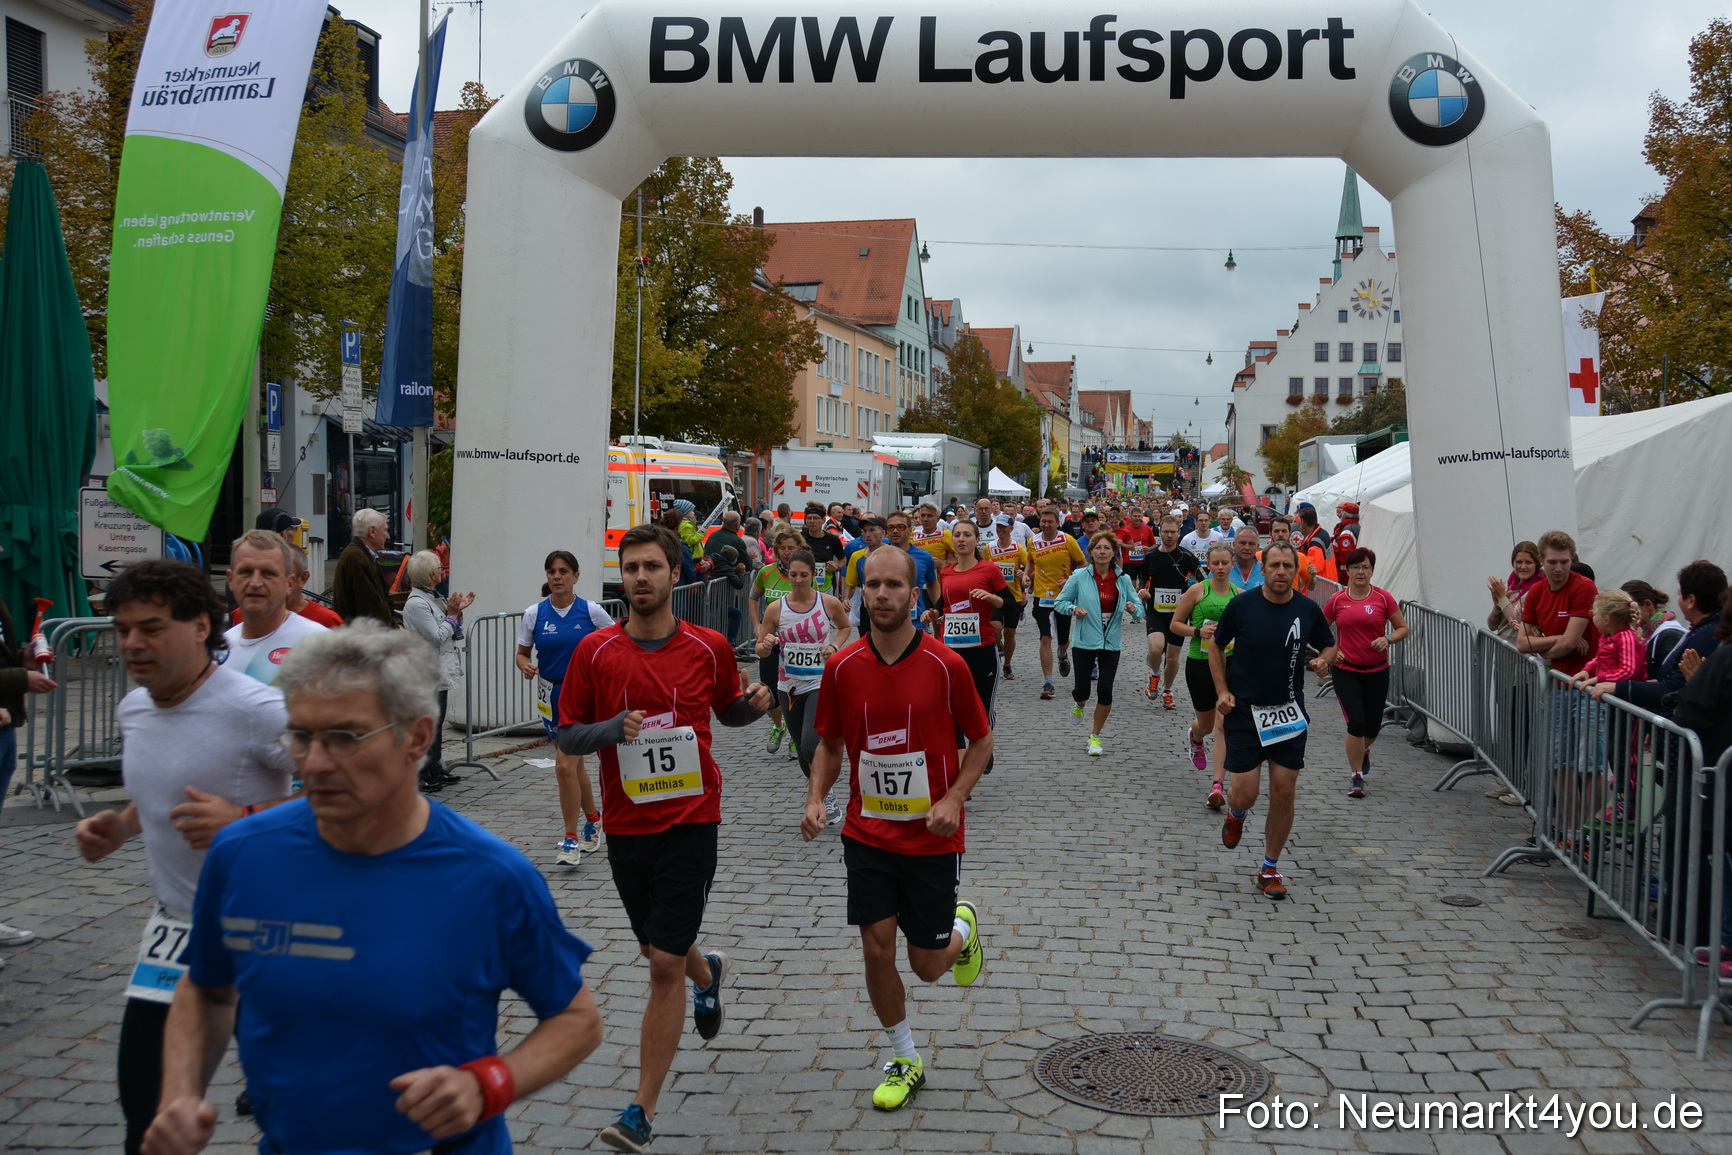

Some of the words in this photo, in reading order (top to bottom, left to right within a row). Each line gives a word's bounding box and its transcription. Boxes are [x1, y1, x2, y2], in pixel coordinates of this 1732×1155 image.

[649, 16, 894, 84] BMW
[918, 14, 1357, 100] Laufsport
[537, 60, 609, 92] BMW
[1398, 53, 1473, 86] BMW
[346, 332, 356, 358] P
[400, 382, 434, 396] railon
[270, 390, 278, 424] P
[456, 448, 580, 464] www.bmw-laufsport.de
[1438, 446, 1570, 465] www.bmw-laufsport.de
[97, 510, 144, 519] Lammsbr
[94, 521, 131, 532] Kreuzung
[133, 522, 151, 531] über
[109, 533, 136, 541] Untere
[98, 544, 148, 554] Kaserngasse
[1035, 551, 1050, 559] MAX
[1160, 594, 1177, 604] 139
[947, 621, 977, 635] 2594
[787, 651, 821, 666] 2054
[1259, 705, 1299, 729] 2209
[641, 719, 662, 731] DEHN
[1271, 725, 1297, 737] Thomas
[644, 734, 683, 746] Neumarkt
[878, 735, 897, 744] DEHN
[642, 746, 676, 774] 15
[860, 757, 877, 768] PARTL
[878, 761, 913, 769] Neumarkt
[638, 778, 685, 793] Matthias
[870, 771, 912, 796] 157
[879, 800, 909, 812] Tobias
[935, 932, 950, 940] JAKO
